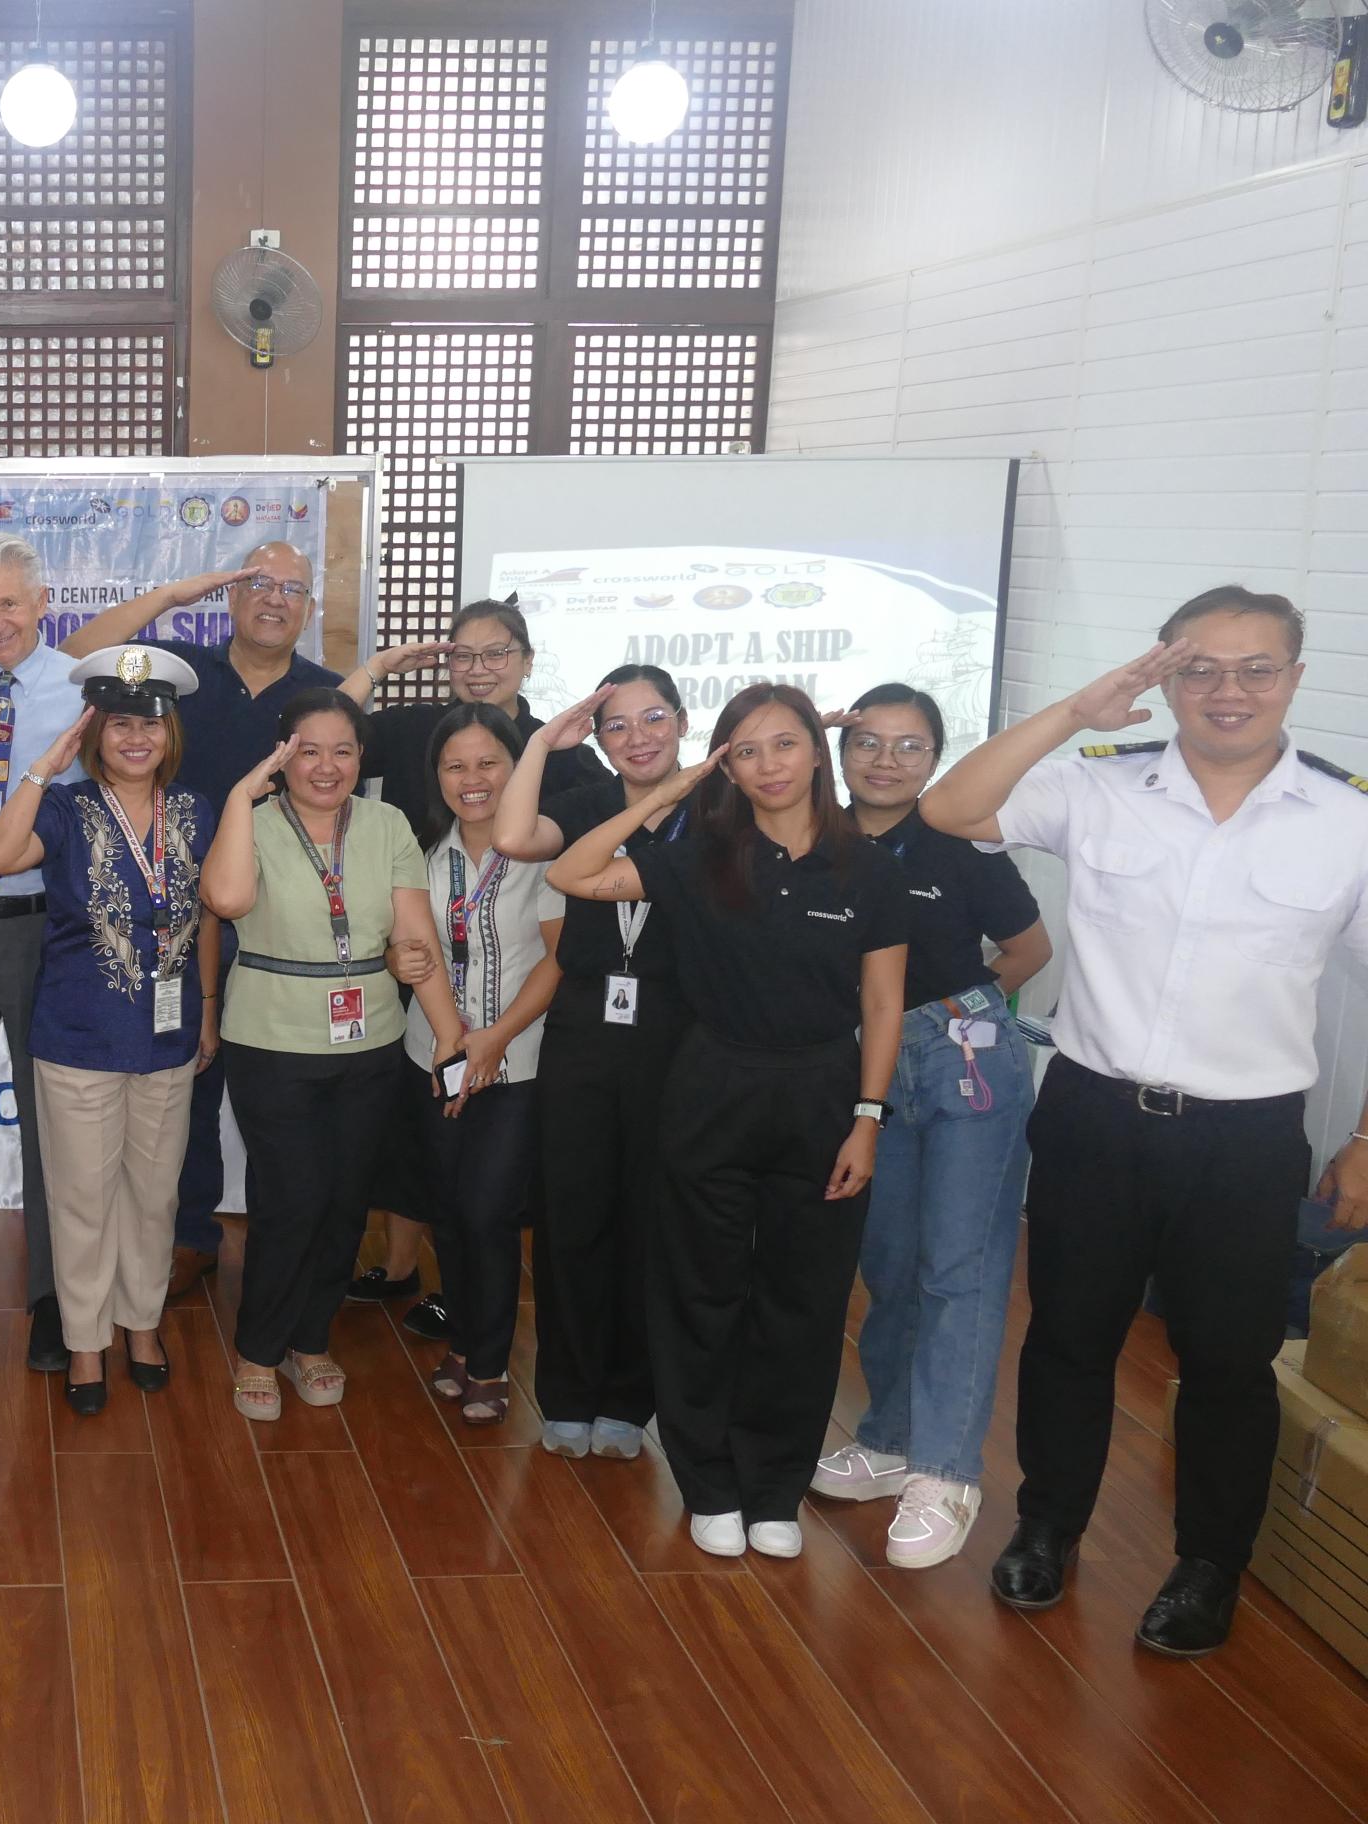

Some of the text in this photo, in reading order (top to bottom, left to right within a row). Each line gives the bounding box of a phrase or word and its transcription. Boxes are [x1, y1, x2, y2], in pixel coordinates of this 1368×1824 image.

[25, 512, 96, 526] crossworld
[724, 563, 826, 577] GOLD
[593, 572, 697, 585] crossworld
[60, 585, 128, 604] CENTRAL
[622, 628, 854, 669] ADOPT A SHIP
[107, 796, 123, 818] SCHOOLS
[120, 818, 134, 839] DIVISION
[130, 838, 137, 847] OF
[134, 846, 142, 859] SAN
[807, 910, 848, 922] crossworld
